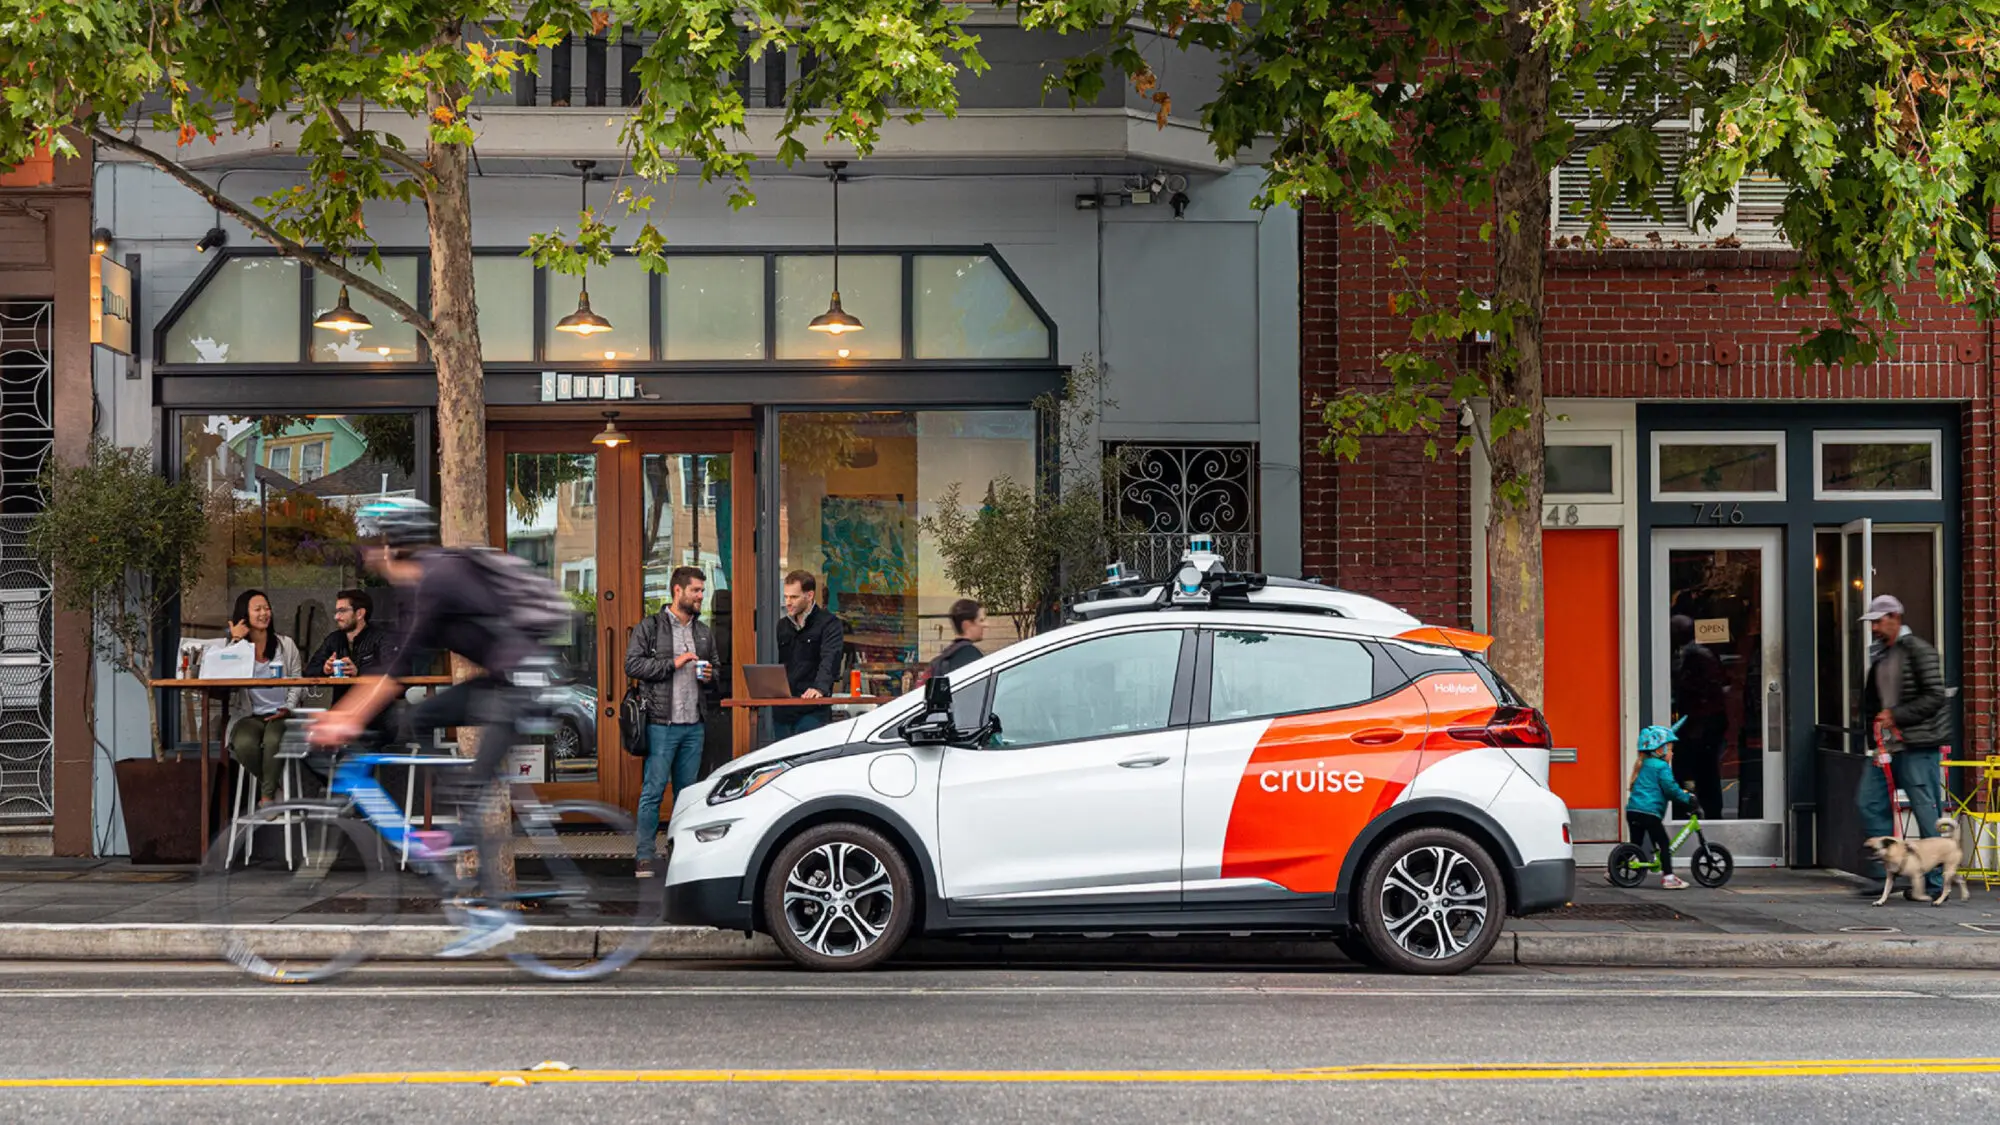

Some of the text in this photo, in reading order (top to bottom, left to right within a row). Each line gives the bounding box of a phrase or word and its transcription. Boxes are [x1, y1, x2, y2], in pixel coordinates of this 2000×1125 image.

[544, 376, 633, 397] SOUVLA
[1691, 502, 1744, 524] 746
[1699, 624, 1725, 634] OPEN
[1434, 683, 1478, 696] Hollyleaf
[1259, 760, 1365, 793] cruise
